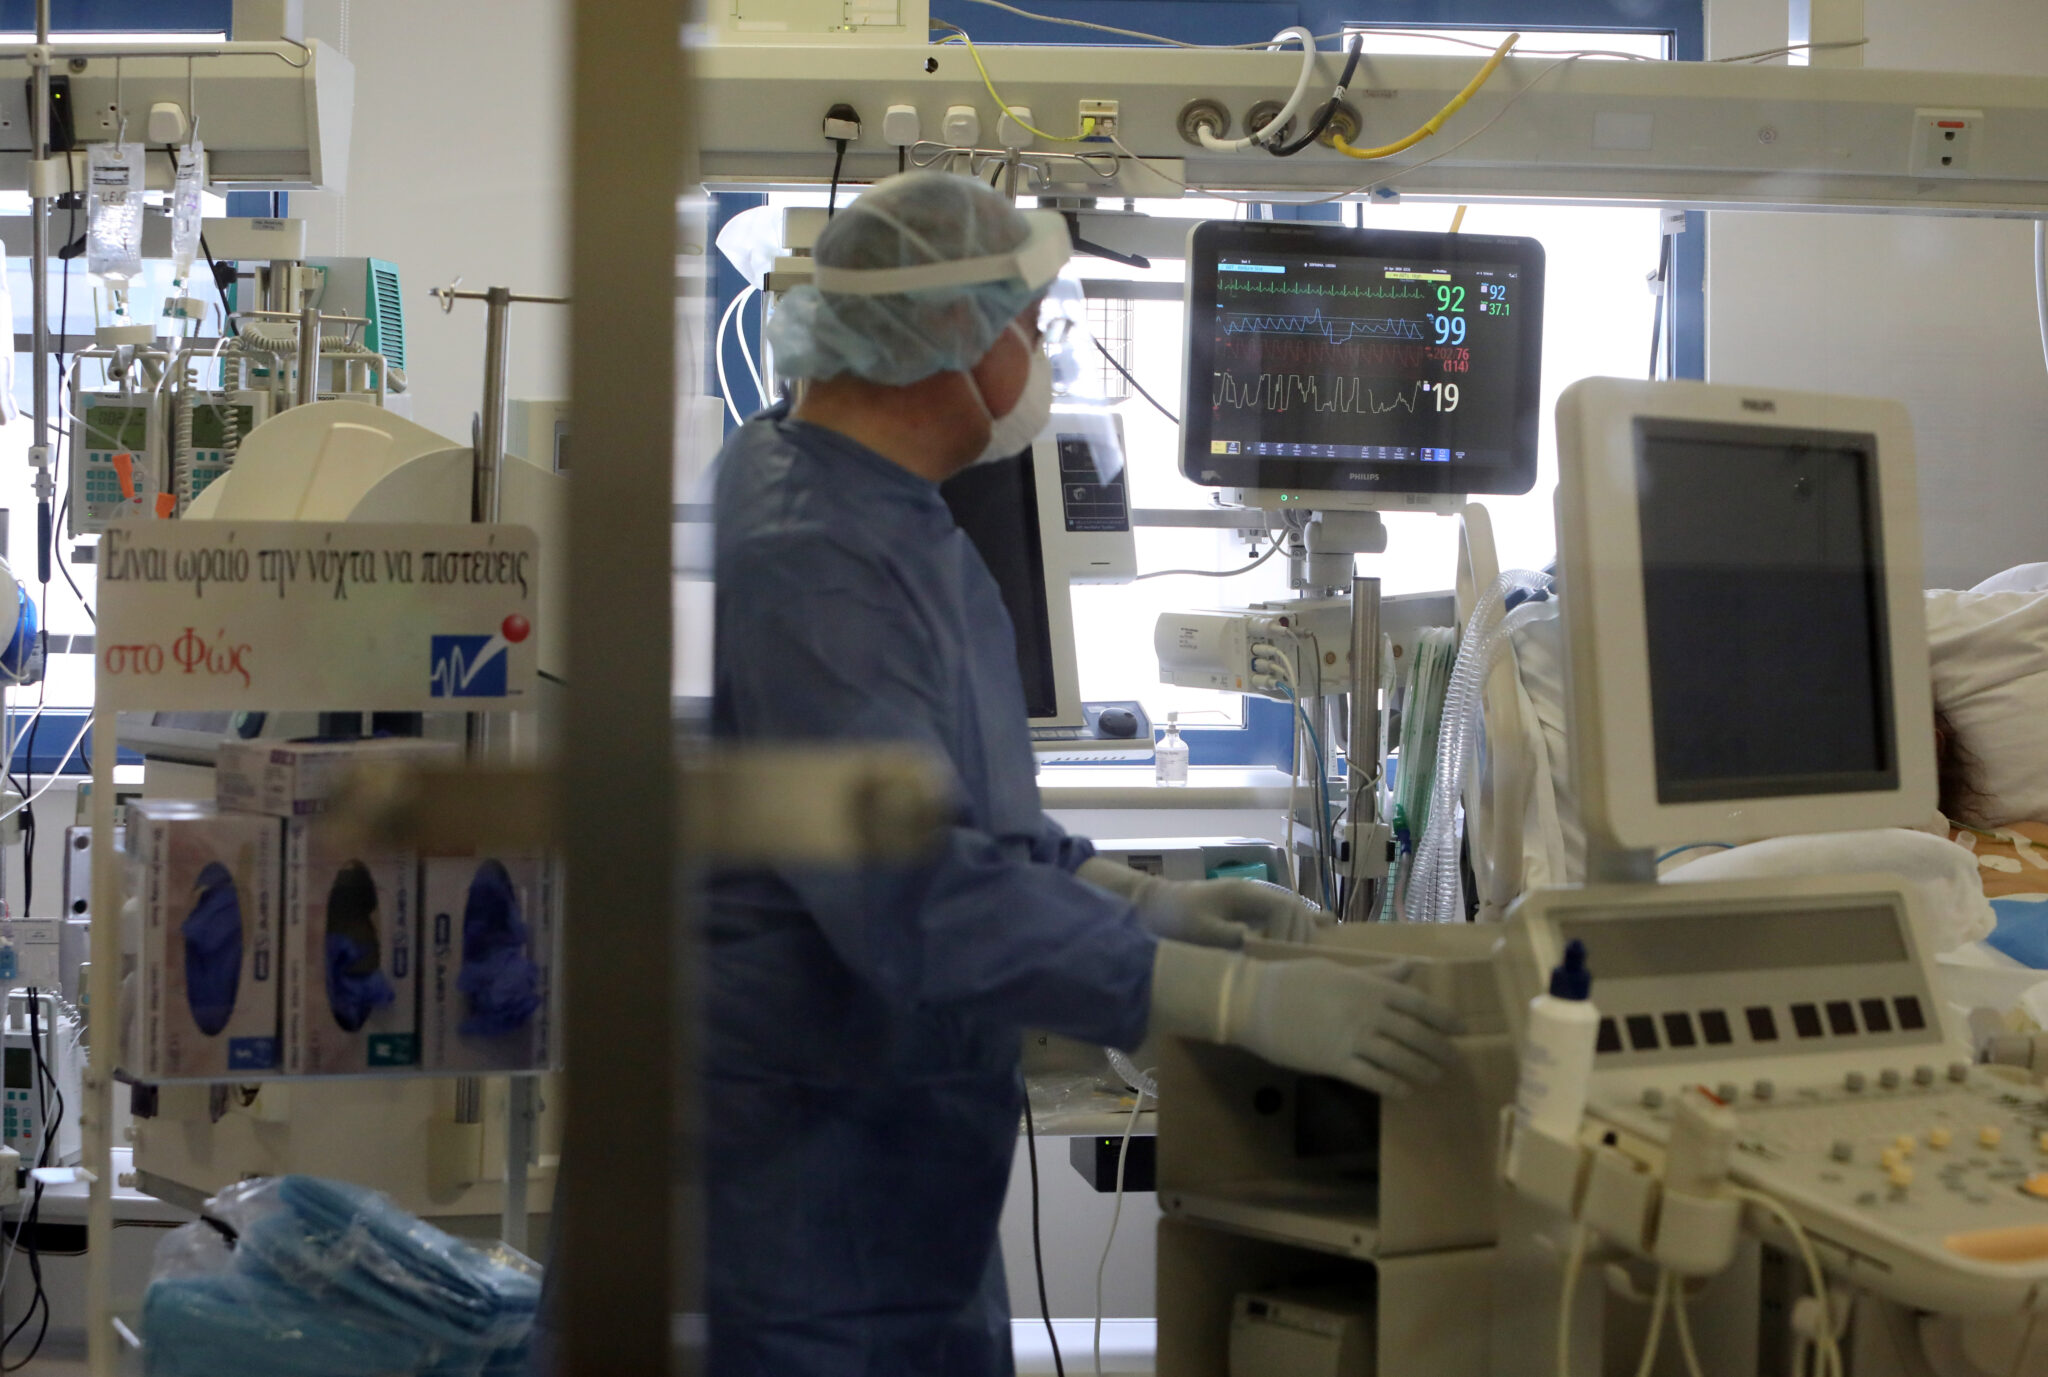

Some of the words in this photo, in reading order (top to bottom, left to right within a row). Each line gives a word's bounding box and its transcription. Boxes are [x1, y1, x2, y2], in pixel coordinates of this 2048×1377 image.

[1436, 285, 1466, 312] 92
[1489, 285, 1506, 301] 92
[1488, 302, 1510, 316] 37.1
[1434, 315, 1466, 345] 99
[1443, 359, 1469, 373] (114)
[1431, 382, 1459, 412] 19
[1349, 472, 1380, 481] PHILIPS
[105, 528, 167, 582] Είναι
[173, 532, 249, 598] ωραίο
[258, 549, 299, 599] την
[307, 532, 377, 600] νύχτα
[384, 549, 414, 584] να
[421, 534, 530, 599] πιστεύεις
[105, 642, 164, 675] στο
[172, 627, 252, 688] Φώς
